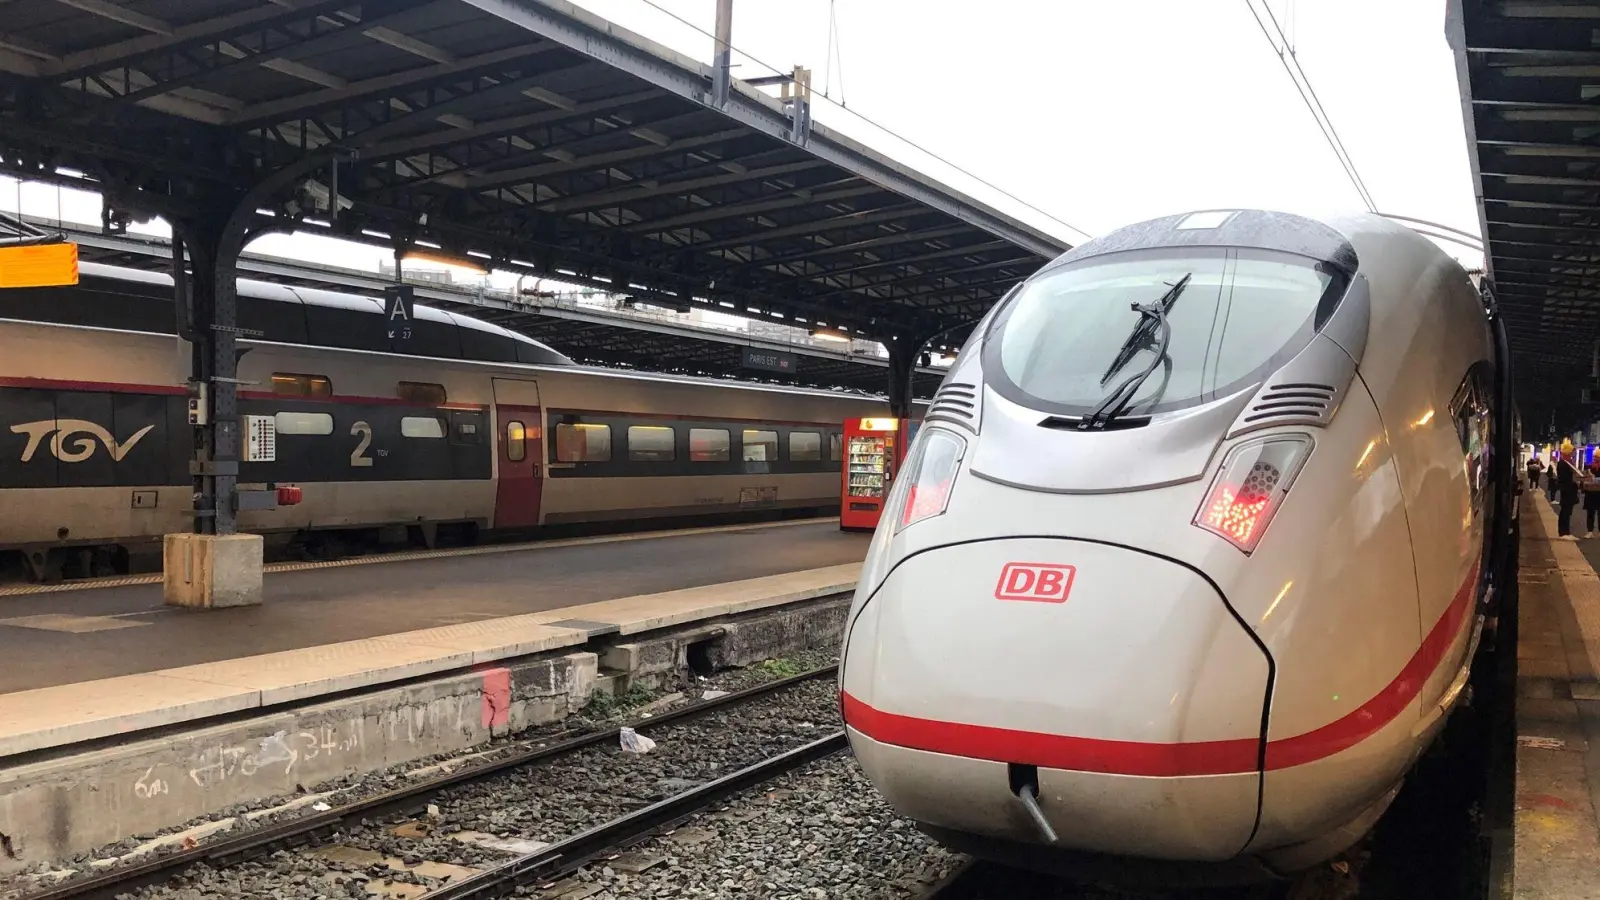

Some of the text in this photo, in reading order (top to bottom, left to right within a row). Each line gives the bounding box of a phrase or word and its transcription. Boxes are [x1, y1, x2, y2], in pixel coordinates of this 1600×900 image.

[390, 296, 408, 320] A
[750, 353, 777, 366] PARIS EST
[10, 419, 155, 462] TGV
[350, 420, 373, 467] 2
[376, 449, 389, 457] TGV
[1005, 568, 1064, 596] DB
